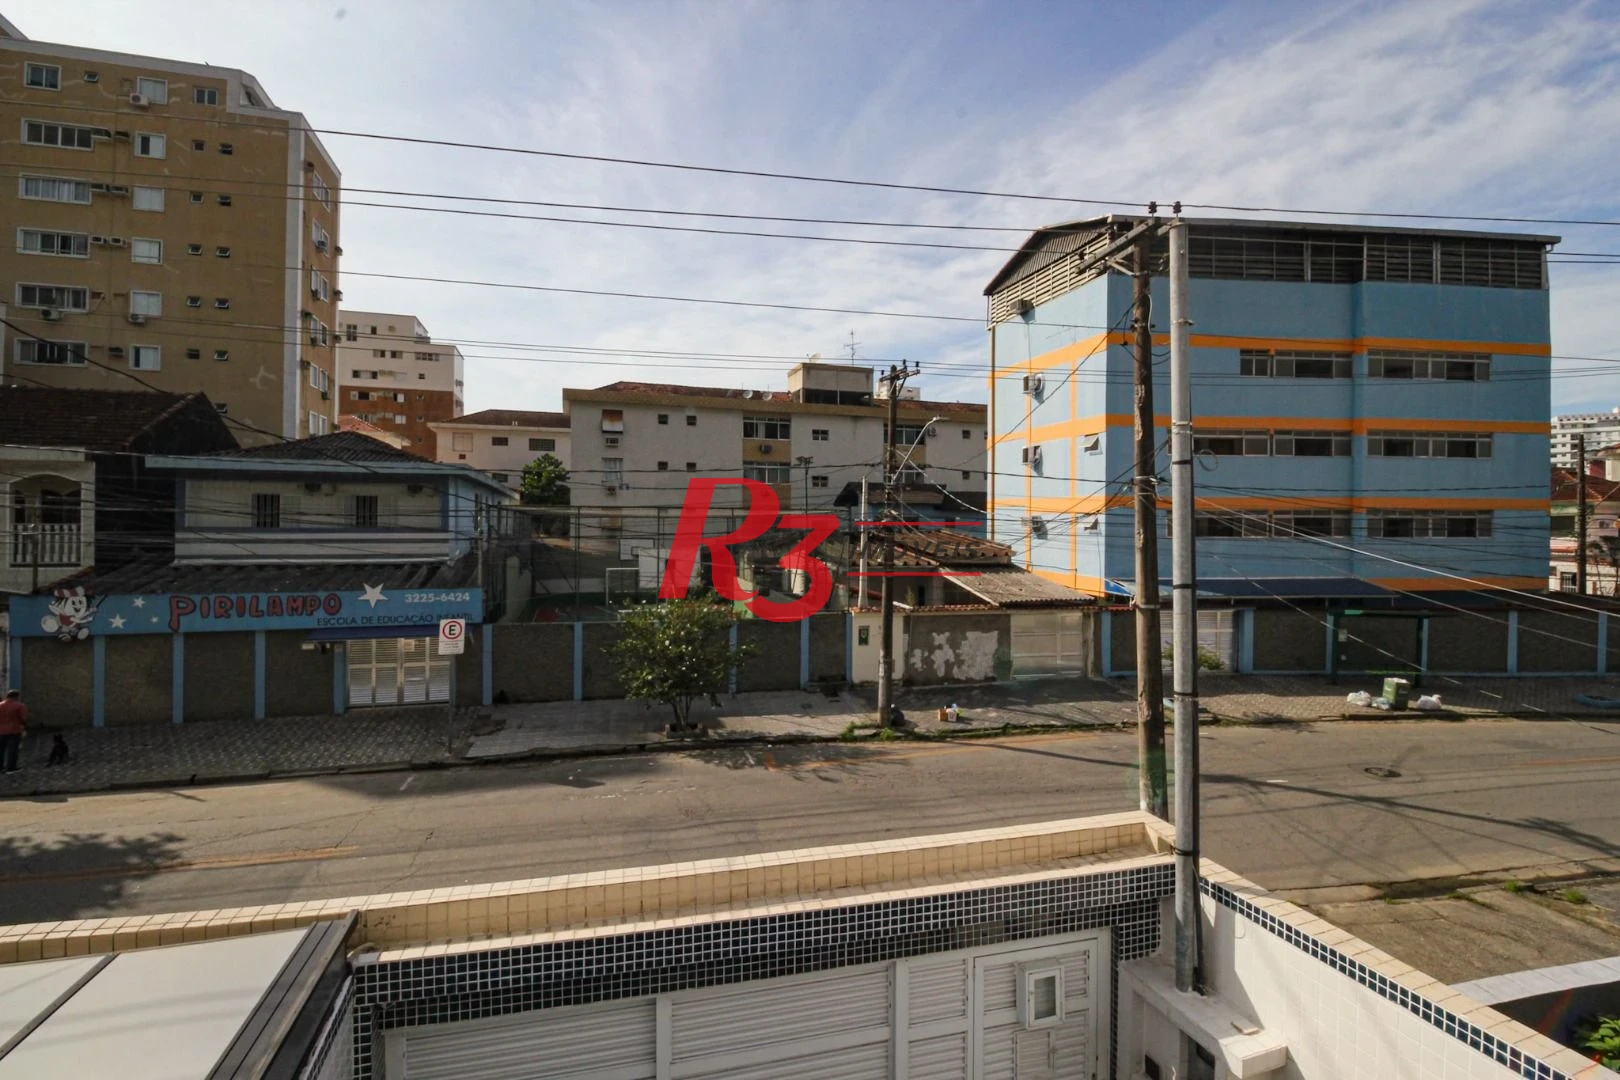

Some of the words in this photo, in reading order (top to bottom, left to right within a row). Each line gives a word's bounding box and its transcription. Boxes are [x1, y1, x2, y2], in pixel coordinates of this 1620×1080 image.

[404, 592, 470, 603] 3225-6424
[168, 593, 342, 633] PIRILAMPO
[317, 616, 357, 627] ESCOLA
[361, 616, 374, 625] DE
[377, 613, 434, 625] EDUCAÇÃO
[448, 624, 457, 636] E
